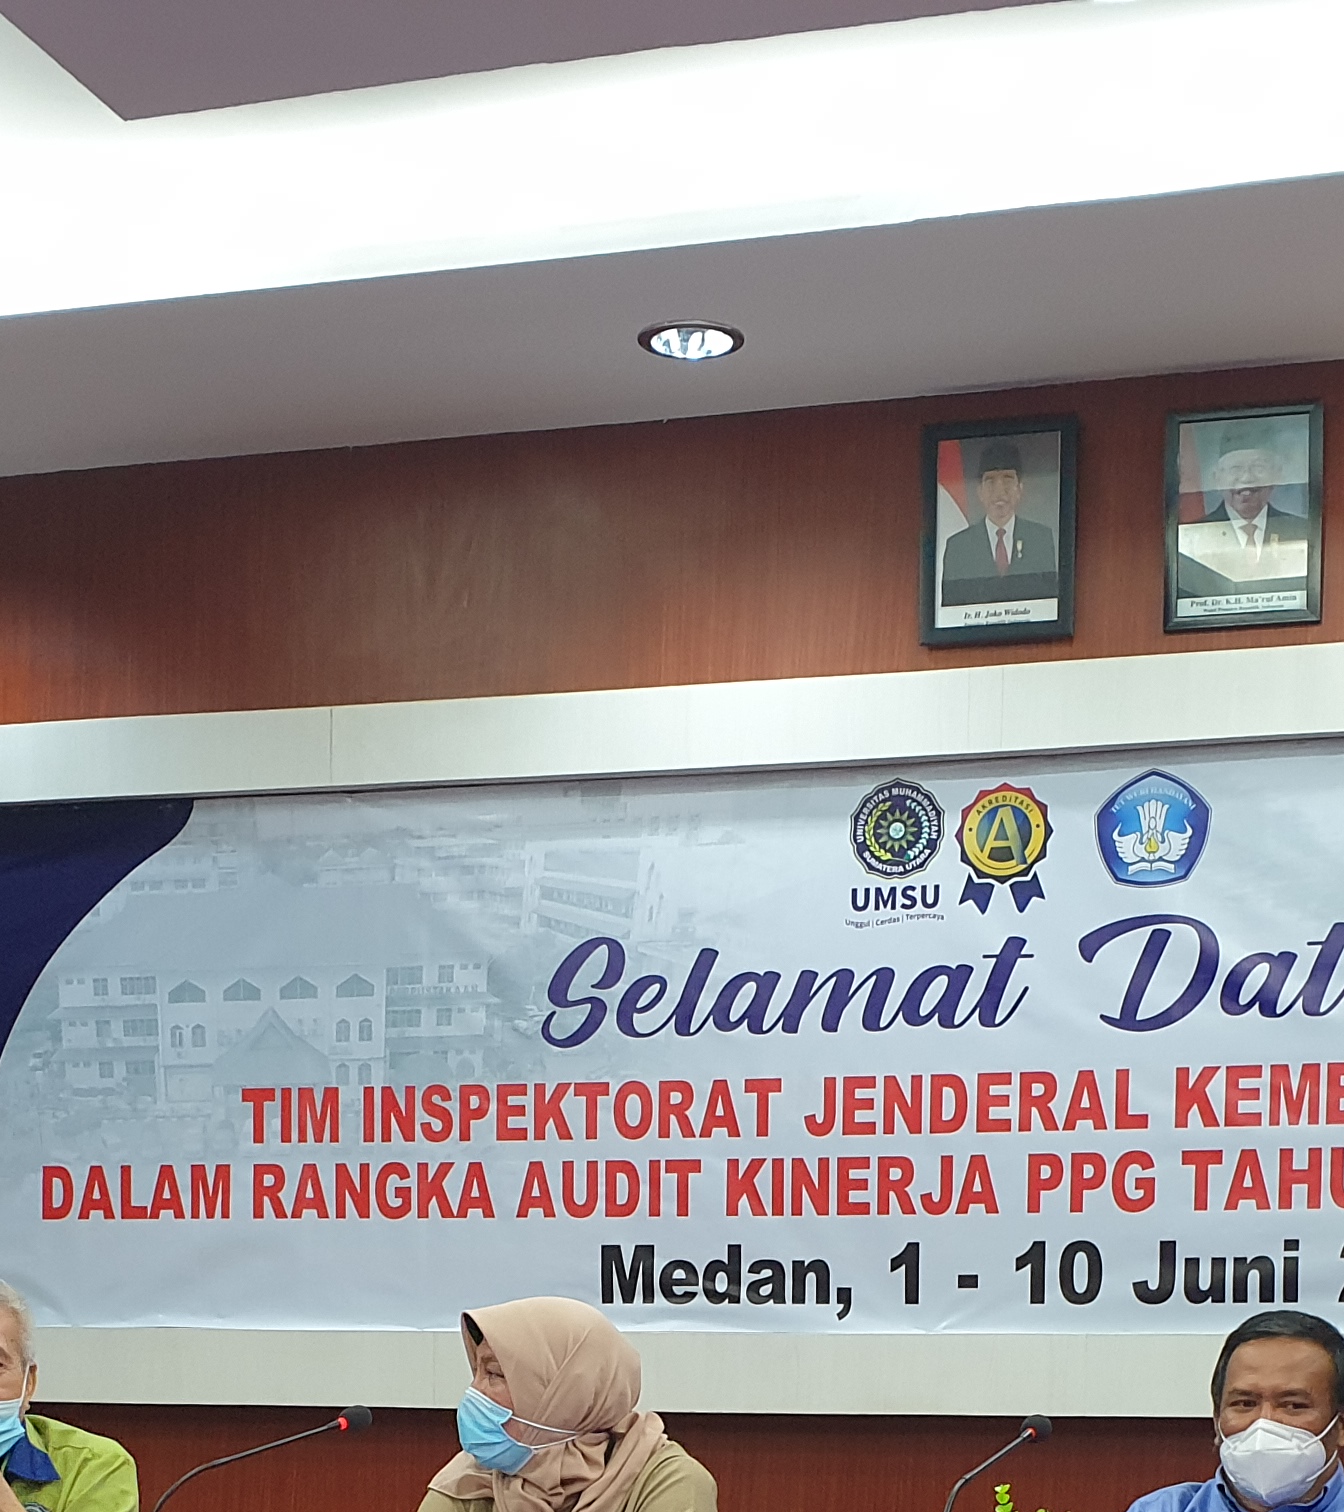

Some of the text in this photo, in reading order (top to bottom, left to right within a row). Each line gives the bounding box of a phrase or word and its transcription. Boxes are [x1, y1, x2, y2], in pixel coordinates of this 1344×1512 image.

[856, 787, 939, 843] UNIVERSITAS MUHAMMADIYAH
[976, 795, 1035, 817] AKREDITASI
[862, 848, 932, 874] SUMATERA UTARA
[981, 806, 1030, 867] A
[850, 884, 941, 913] UMSU
[875, 916, 901, 927] Cerdas
[905, 913, 945, 922] Terpercaya
[541, 936, 1034, 1048] Selamat
[241, 1086, 340, 1144] TIM
[362, 1077, 783, 1143] INSPEKTORAT
[803, 1068, 1150, 1137] JENDERAL
[41, 1163, 232, 1220] DALAM
[252, 1161, 496, 1220] RANGKA
[515, 1158, 703, 1219] AUDIT
[725, 1153, 1000, 1218] KINERJA
[1026, 1149, 1157, 1215] PPG
[600, 1243, 853, 1321] Medan,
[889, 1241, 921, 1305] 1
[1014, 1240, 1104, 1306] 10
[1131, 1238, 1301, 1305] Juni
